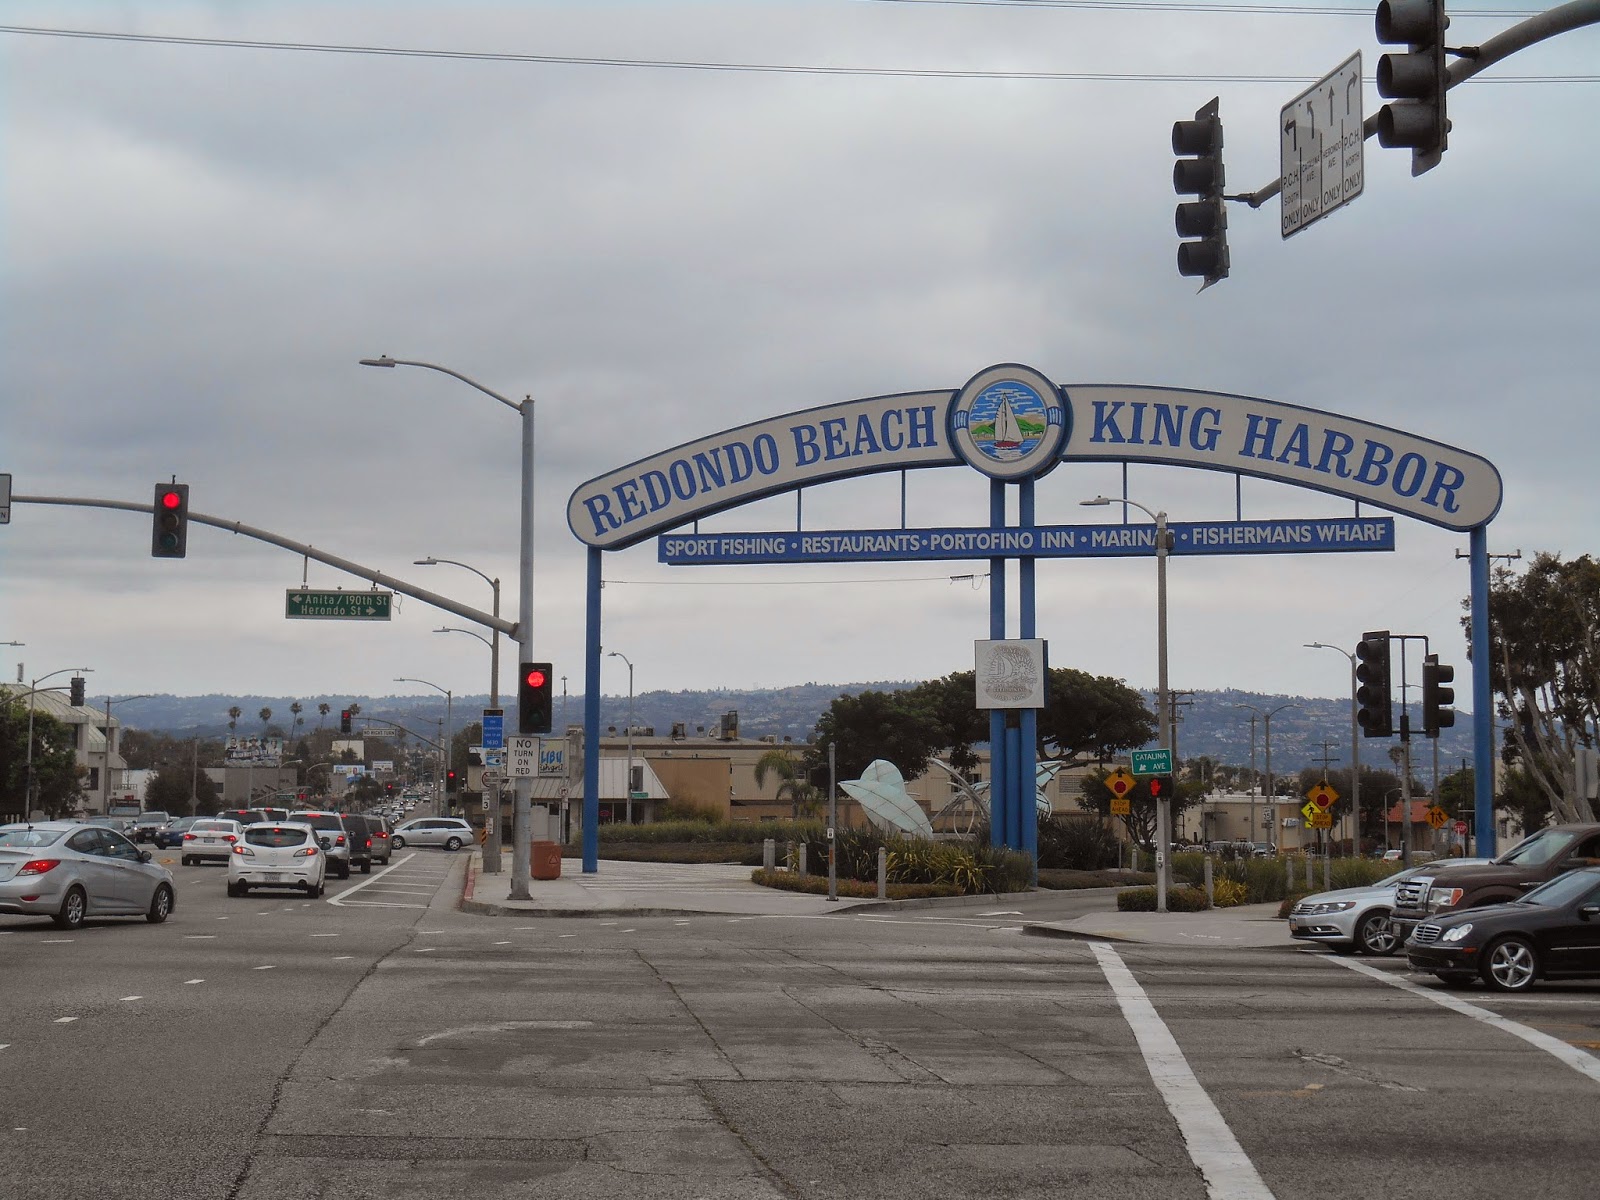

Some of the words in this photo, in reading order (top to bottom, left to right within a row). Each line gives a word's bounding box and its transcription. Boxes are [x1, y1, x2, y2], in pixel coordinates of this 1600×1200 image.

[1345, 151, 1360, 168] NORTH
[1344, 170, 1361, 193] ONLY
[1284, 191, 1299, 207] SOUTH
[1323, 183, 1341, 206] ONLY
[1302, 196, 1320, 218] ONLY
[1283, 208, 1300, 229] ONLY
[1089, 401, 1223, 452] KING
[1239, 413, 1466, 514] HARBOR
[582, 433, 780, 537] REDONDO
[790, 406, 938, 467] BEACH
[665, 539, 718, 557] SPORT
[721, 538, 786, 555] FISHING
[801, 535, 920, 554] RESTAURANTS
[930, 531, 1034, 551] PORTOFINO
[1041, 531, 1075, 549] INN
[1192, 525, 1312, 545] FISHERMANS
[1316, 523, 1386, 542] WHARF
[376, 595, 387, 605] St
[301, 605, 346, 615] Herondo
[350, 606, 362, 615] St
[516, 740, 532, 748] NO
[1135, 752, 1168, 761] CATALINA
[515, 767, 530, 775] RED
[1152, 762, 1166, 770] AVE
[483, 801, 489, 809] 3
